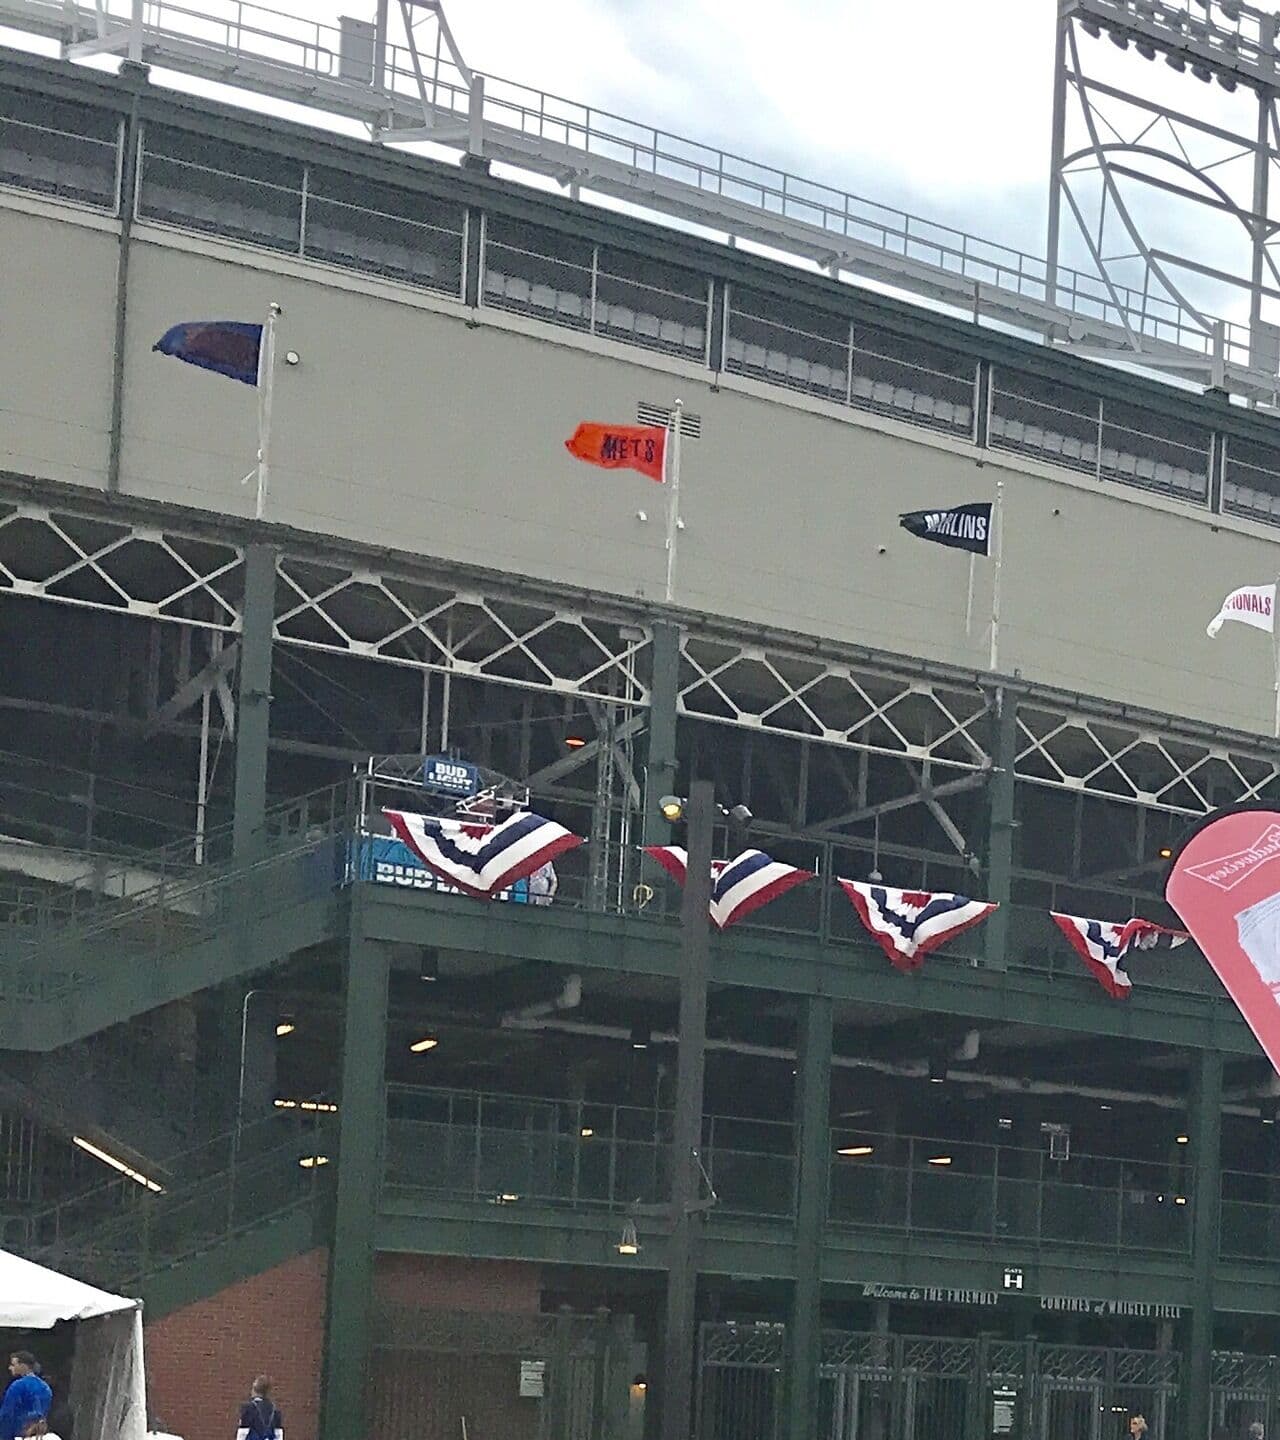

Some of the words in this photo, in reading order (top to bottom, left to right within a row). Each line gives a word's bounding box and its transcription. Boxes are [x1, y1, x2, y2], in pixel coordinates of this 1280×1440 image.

[601, 433, 655, 463] METS
[434, 762, 467, 778] BUD
[376, 862, 433, 889] BUD
[1004, 1274, 1023, 1289] H
[863, 1283, 907, 1299] Welcome
[909, 1288, 920, 1300] to
[924, 1287, 943, 1301] THE
[948, 1289, 998, 1305] FRIENDLY
[1040, 1296, 1090, 1313] CONFINES
